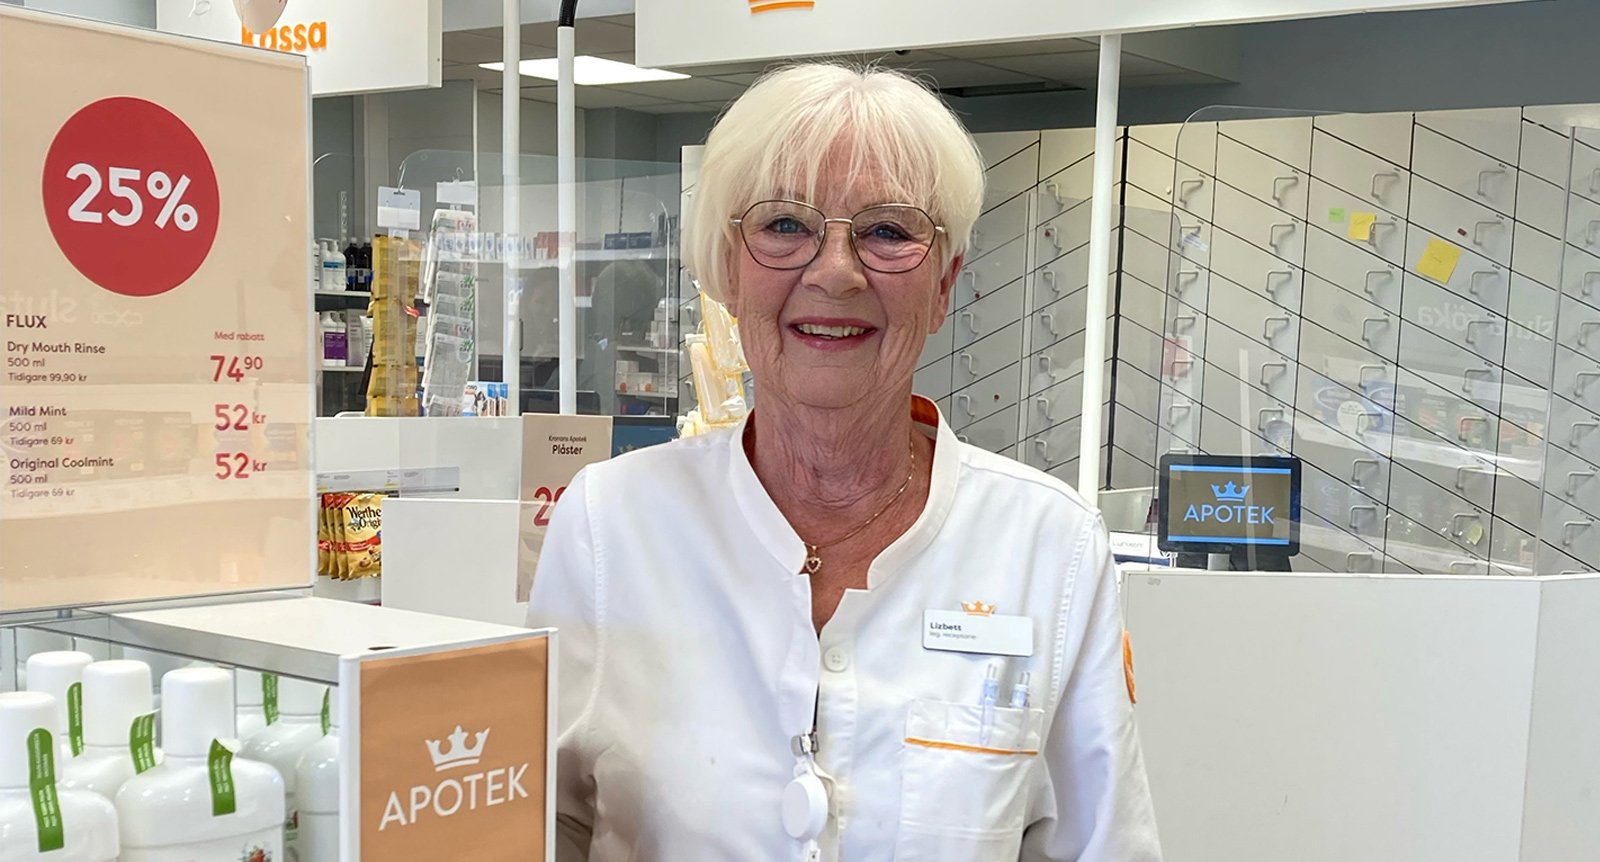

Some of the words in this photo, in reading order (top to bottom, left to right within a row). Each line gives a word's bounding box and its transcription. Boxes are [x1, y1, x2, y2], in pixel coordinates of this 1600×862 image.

[66, 162, 199, 232] 25%
[6, 314, 47, 328] FLUX
[214, 331, 235, 341] Med
[236, 332, 265, 341] rabatt
[7, 341, 28, 355] Dry
[32, 342, 72, 353] Mouth
[74, 343, 106, 354] Rinse
[7, 357, 30, 367] 500
[33, 357, 46, 367] ml
[8, 372, 48, 384] Tidigare
[78, 373, 88, 382] kr
[9, 405, 36, 417] Mild
[39, 405, 67, 417] Mint
[214, 403, 249, 431] 52
[251, 411, 267, 425] kr
[9, 422, 32, 432] 500
[34, 421, 47, 432] ml
[9, 436, 49, 448] Tidigare
[50, 436, 63, 446] 69
[64, 436, 75, 446] kr
[552, 443, 584, 455] Plåster
[10, 457, 59, 472] Original
[61, 456, 114, 469] Coolmint
[215, 452, 249, 480] 52
[252, 459, 268, 473] kr
[10, 474, 33, 485] 500
[35, 473, 48, 484] ml
[10, 487, 50, 499] Tidigare
[51, 487, 64, 498] 69
[65, 488, 76, 497] kr
[1183, 504, 1275, 525] APOTEK
[930, 622, 962, 632] Lizbett
[378, 763, 529, 832] APOTEK
